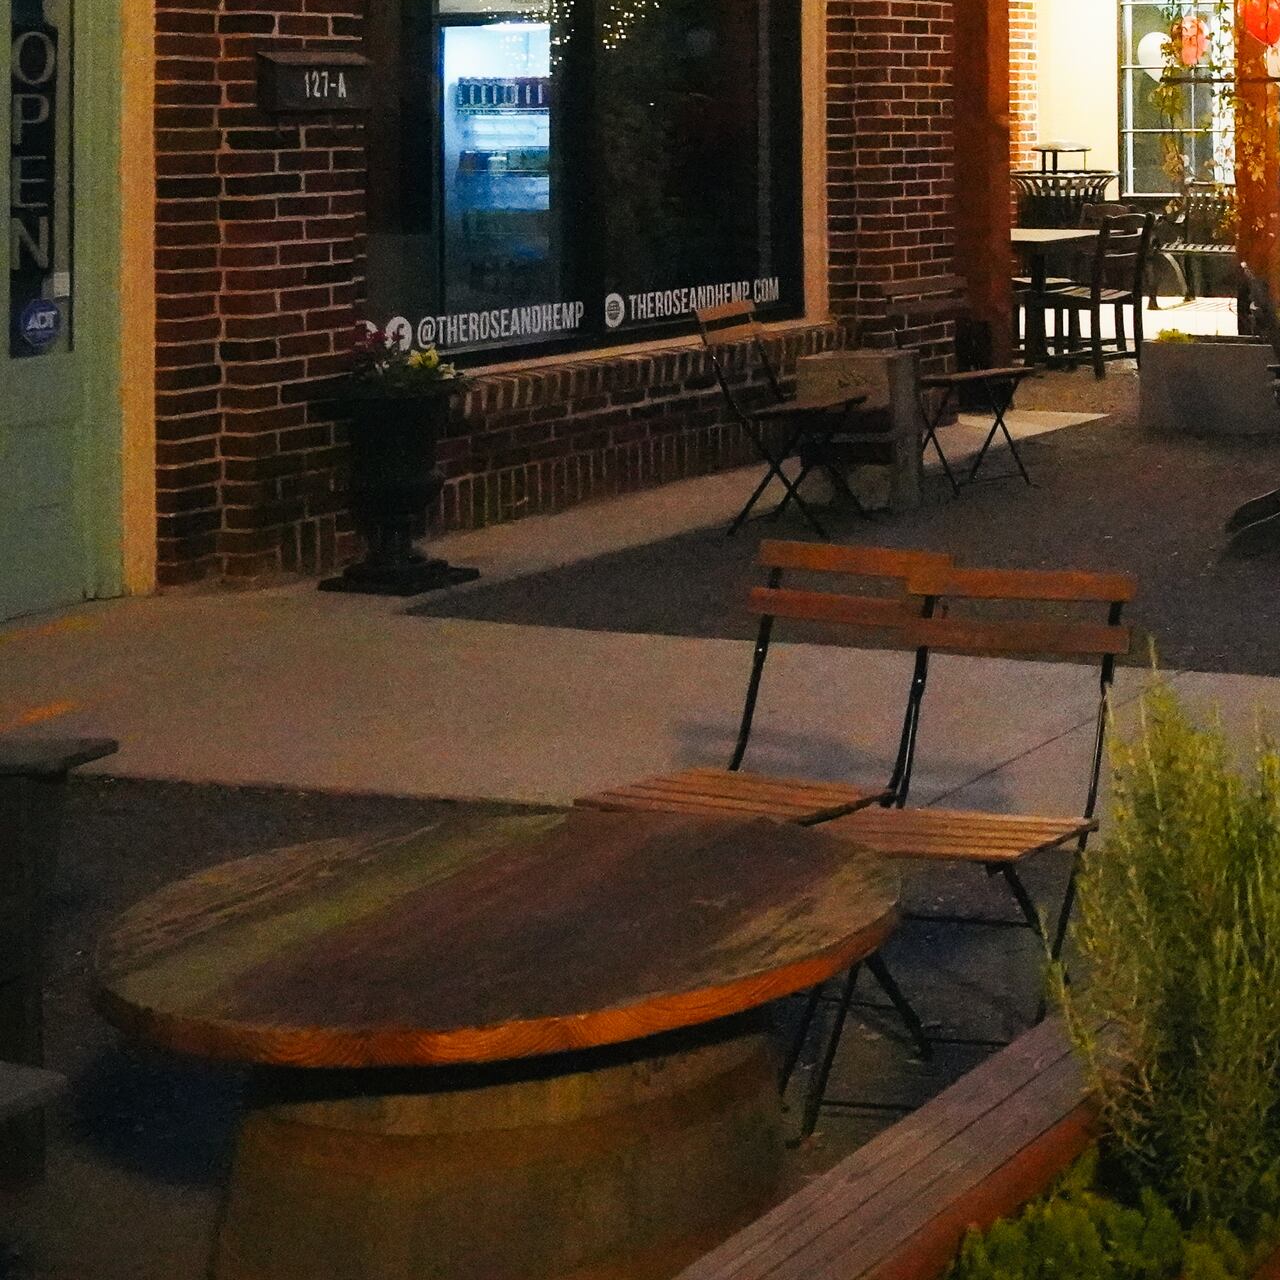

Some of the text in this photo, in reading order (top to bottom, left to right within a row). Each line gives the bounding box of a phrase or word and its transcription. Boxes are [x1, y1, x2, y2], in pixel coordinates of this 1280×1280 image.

[304, 70, 347, 98] 127-A
[11, 31, 56, 272] OPEN
[26, 310, 58, 331] ADT
[417, 300, 585, 350] @THEROSEANDHEMP
